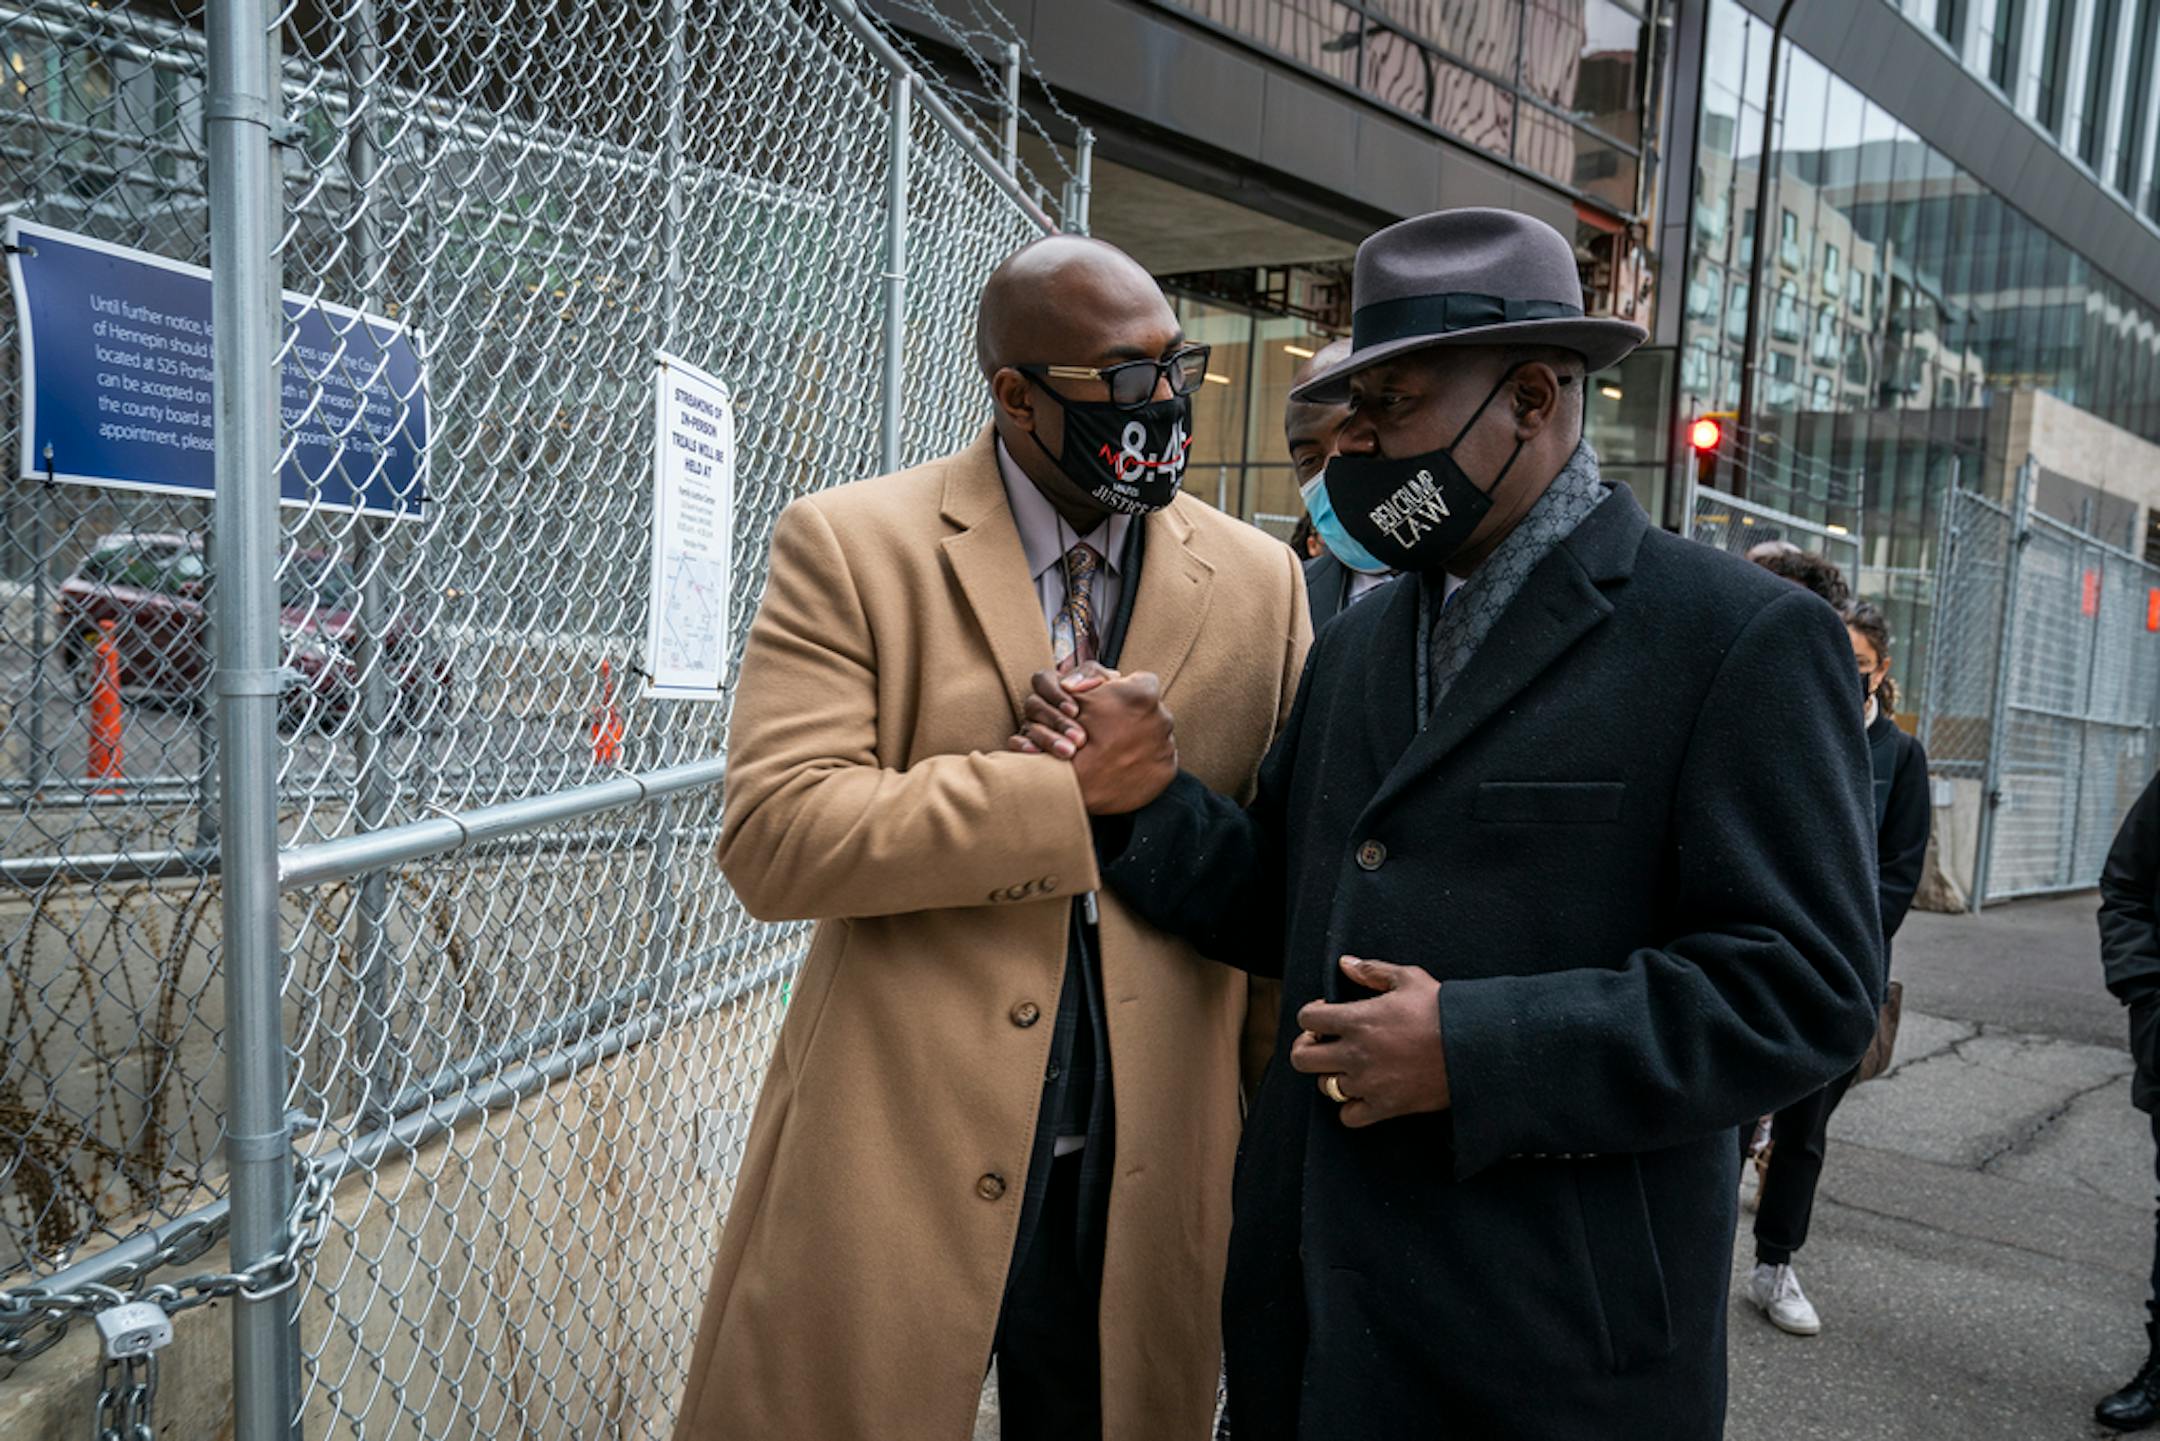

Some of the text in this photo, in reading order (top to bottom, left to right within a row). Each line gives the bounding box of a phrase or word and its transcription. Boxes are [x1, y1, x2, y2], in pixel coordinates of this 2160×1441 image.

[90, 293, 121, 315] Until
[122, 300, 163, 325] further
[165, 315, 203, 336] notice,
[93, 320, 107, 336] of
[109, 322, 168, 350] Hennepin
[170, 337, 208, 358] should
[95, 343, 141, 368] located
[143, 356, 154, 371] at
[157, 357, 178, 375] 525
[180, 361, 214, 383] Portla
[96, 373, 121, 388] can
[122, 374, 140, 392] be
[141, 380, 193, 403] accepted
[195, 391, 211, 404] on
[674, 388, 723, 419] STREAMING OF
[98, 395, 120, 414] the
[122, 402, 165, 424] county
[166, 406, 199, 426] board
[201, 414, 212, 428] at
[681, 411, 717, 438] IN-PERSON
[99, 422, 180, 448] appointment,
[672, 431, 724, 463] TRIALS WILL BE
[685, 457, 712, 477] HELD AT
[1092, 485, 1150, 515] JUSTICE
[1391, 492, 1451, 549] LAW
